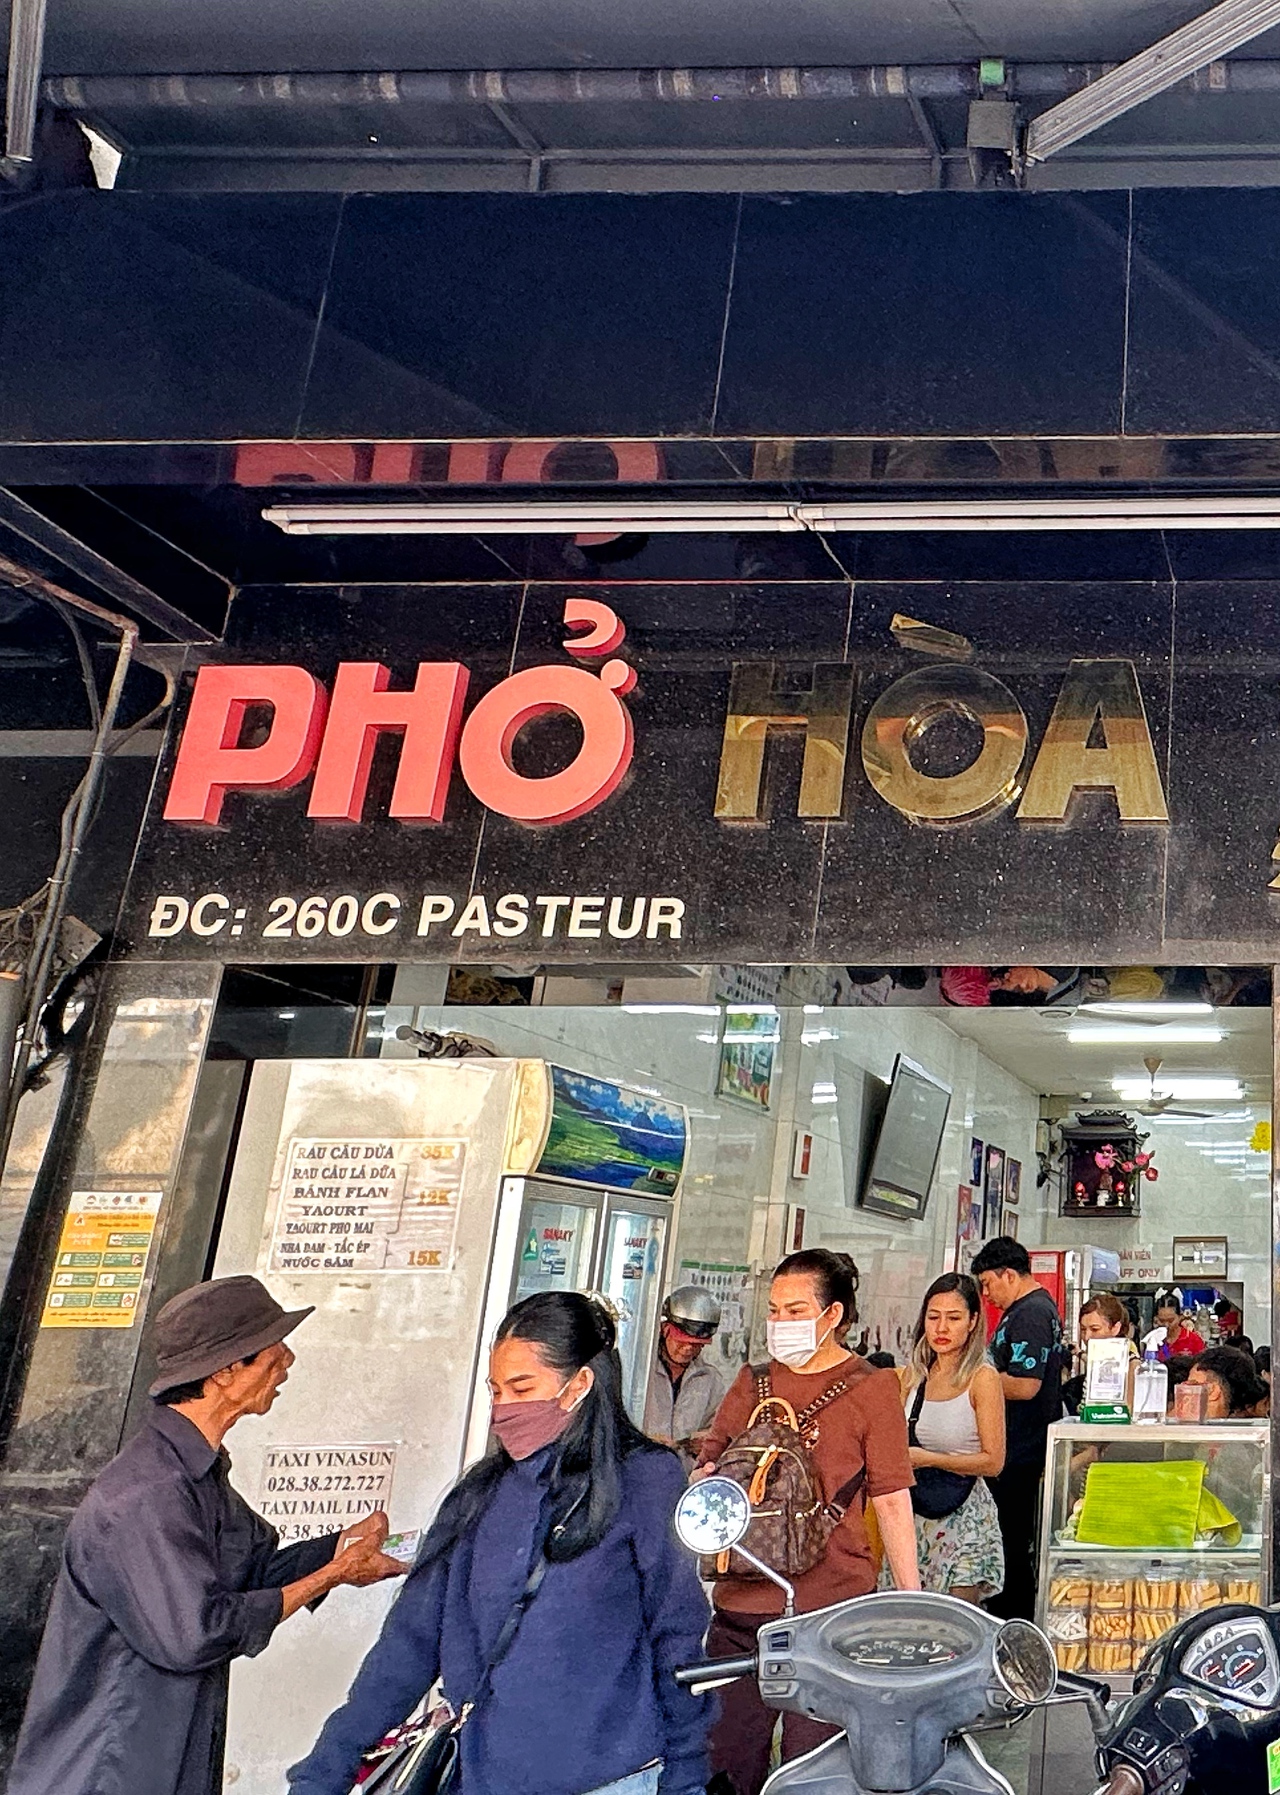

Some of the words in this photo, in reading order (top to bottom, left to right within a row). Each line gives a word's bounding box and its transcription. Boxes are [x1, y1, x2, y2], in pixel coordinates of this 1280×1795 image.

[163, 598, 638, 826] PHỞ
[714, 613, 1169, 826] HÒA
[148, 894, 246, 938] ĐC:
[262, 893, 401, 938] 260C
[417, 894, 686, 940] PASTEUR
[296, 1147, 327, 1159] RAU
[292, 1167, 318, 1180] RAU
[345, 1187, 389, 1198] FLAN
[302, 1206, 369, 1216] YAOURT
[286, 1222, 327, 1234] YAOURT
[353, 1222, 374, 1234] MAI
[407, 1251, 442, 1266] 15K
[267, 1453, 310, 1468] TAXI
[316, 1451, 395, 1467] VINASUN
[267, 1475, 386, 1492] 028.38.272.727
[260, 1500, 298, 1515] TAXI
[300, 1499, 343, 1515] MAIL
